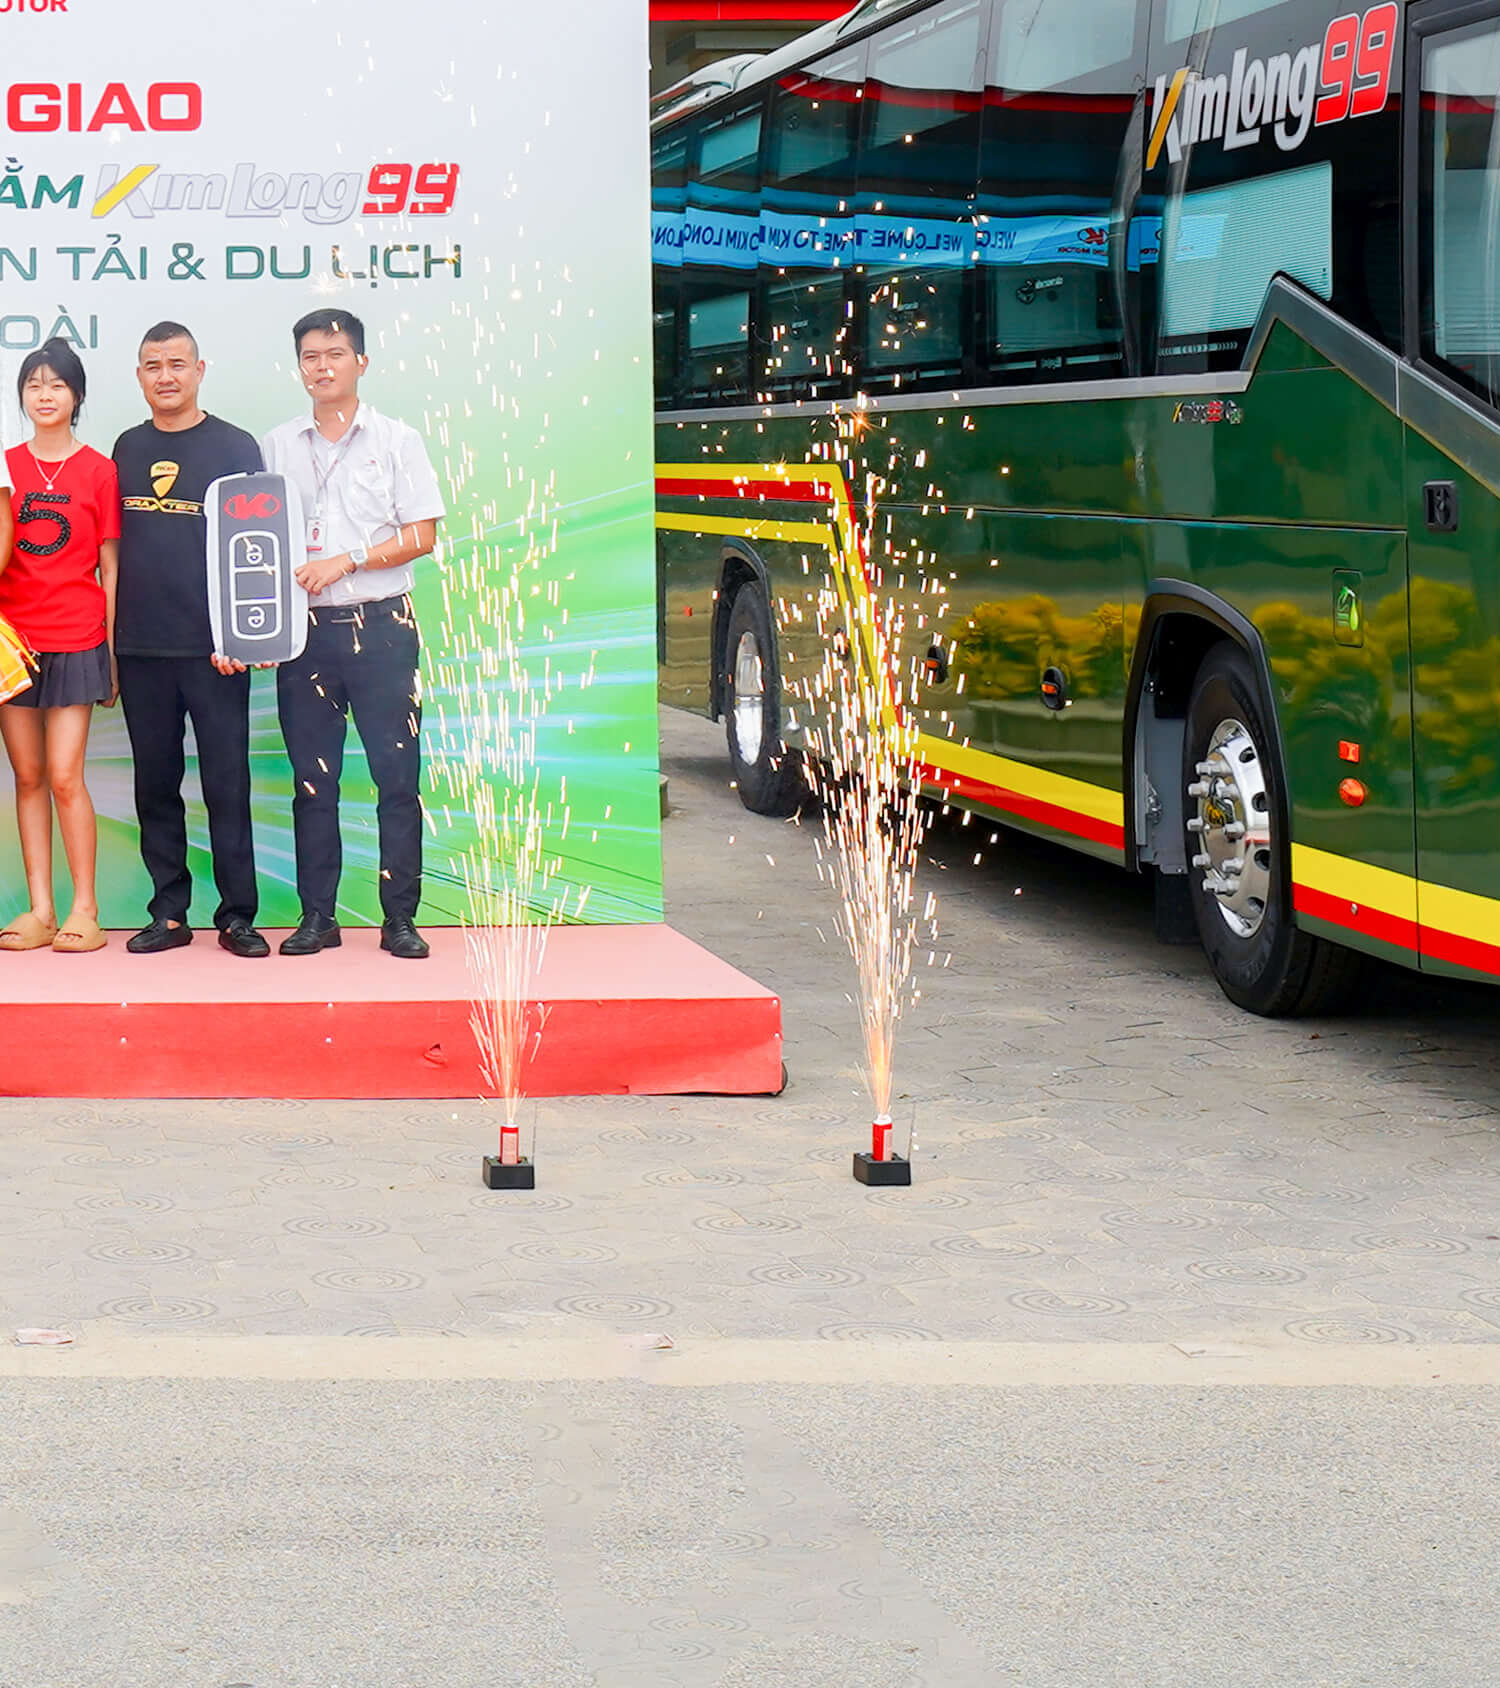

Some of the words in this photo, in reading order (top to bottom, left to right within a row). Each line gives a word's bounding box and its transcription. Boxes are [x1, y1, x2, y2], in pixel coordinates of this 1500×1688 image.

[5, 81, 203, 133] GIAO
[55, 234, 147, 281] TẢI
[167, 243, 207, 281] &
[225, 243, 311, 280] DU
[331, 244, 462, 288] LỊCH
[16, 491, 72, 556] 5
